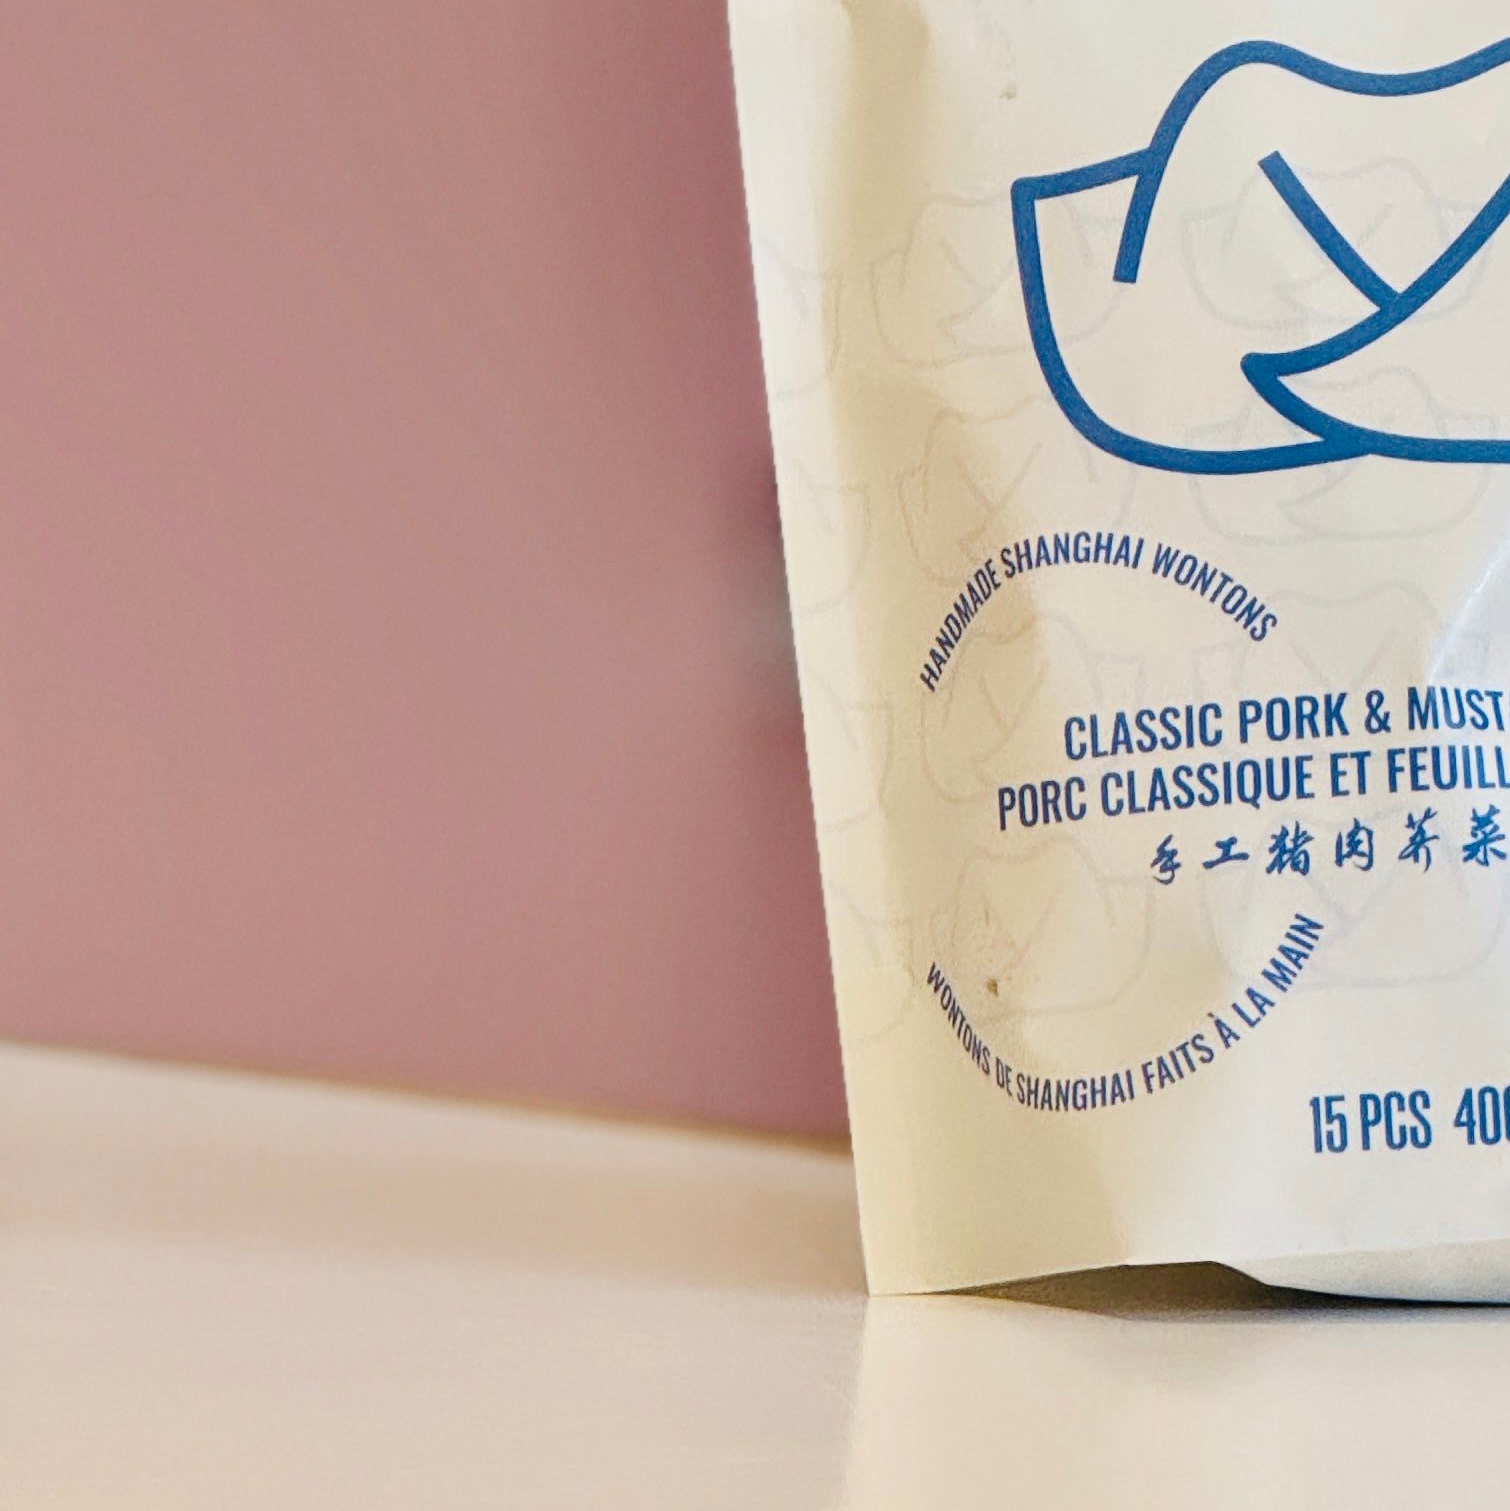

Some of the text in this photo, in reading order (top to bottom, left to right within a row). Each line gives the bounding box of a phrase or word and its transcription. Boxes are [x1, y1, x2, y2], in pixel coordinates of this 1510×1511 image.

[919, 530, 1278, 692] HANDMADE SHANGHAI WONTONS
[1064, 702, 1223, 760] CLASSIC
[1239, 691, 1349, 743] PORK
[1364, 689, 1392, 735] &
[998, 776, 1087, 831] PORC
[1101, 754, 1314, 817] CLASSIQUE
[1329, 750, 1372, 797] ET
[926, 912, 1324, 1113] WONTONS DE SHANGHAI FAITS À LA MAIN
[1309, 1094, 1349, 1154] 15
[1359, 1089, 1433, 1151] PCS
